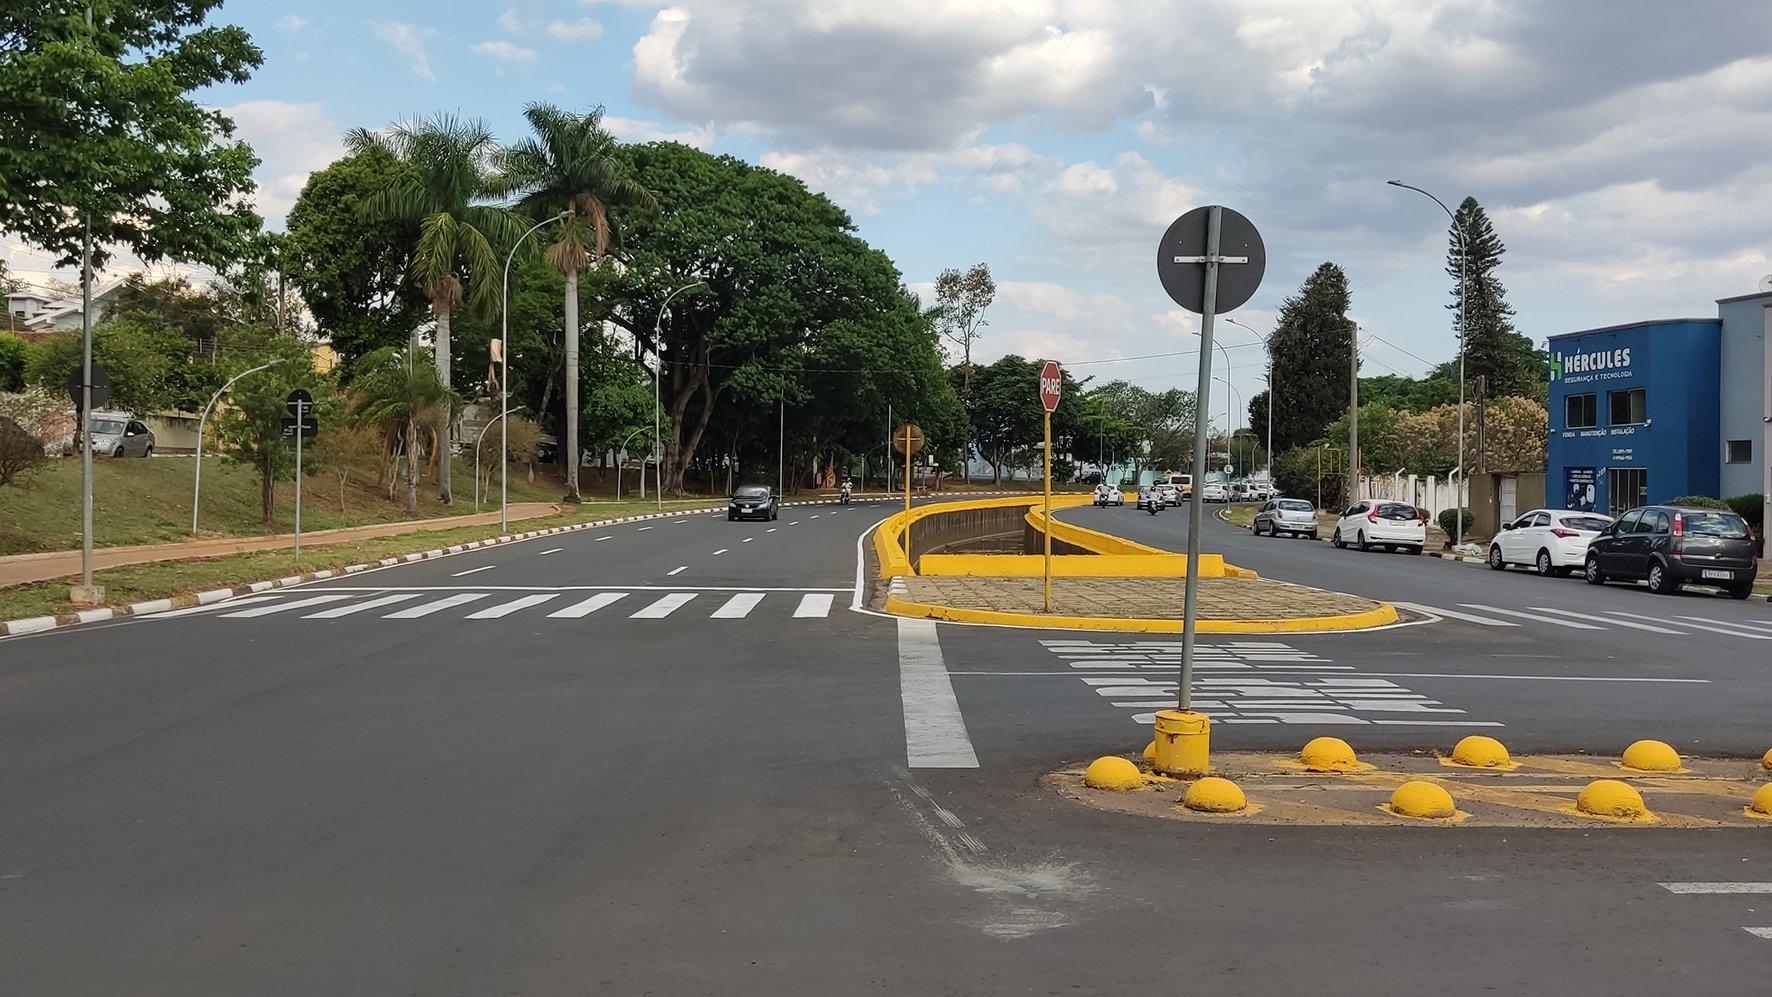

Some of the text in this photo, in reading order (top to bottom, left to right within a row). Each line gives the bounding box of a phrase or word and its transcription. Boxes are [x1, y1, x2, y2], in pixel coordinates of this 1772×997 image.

[1564, 348, 1630, 373] HÉRCULES
[1042, 377, 1060, 395] PARE
[1564, 375, 1594, 384] SEGURANÇA
[1600, 371, 1632, 380] TECNOLOGIA
